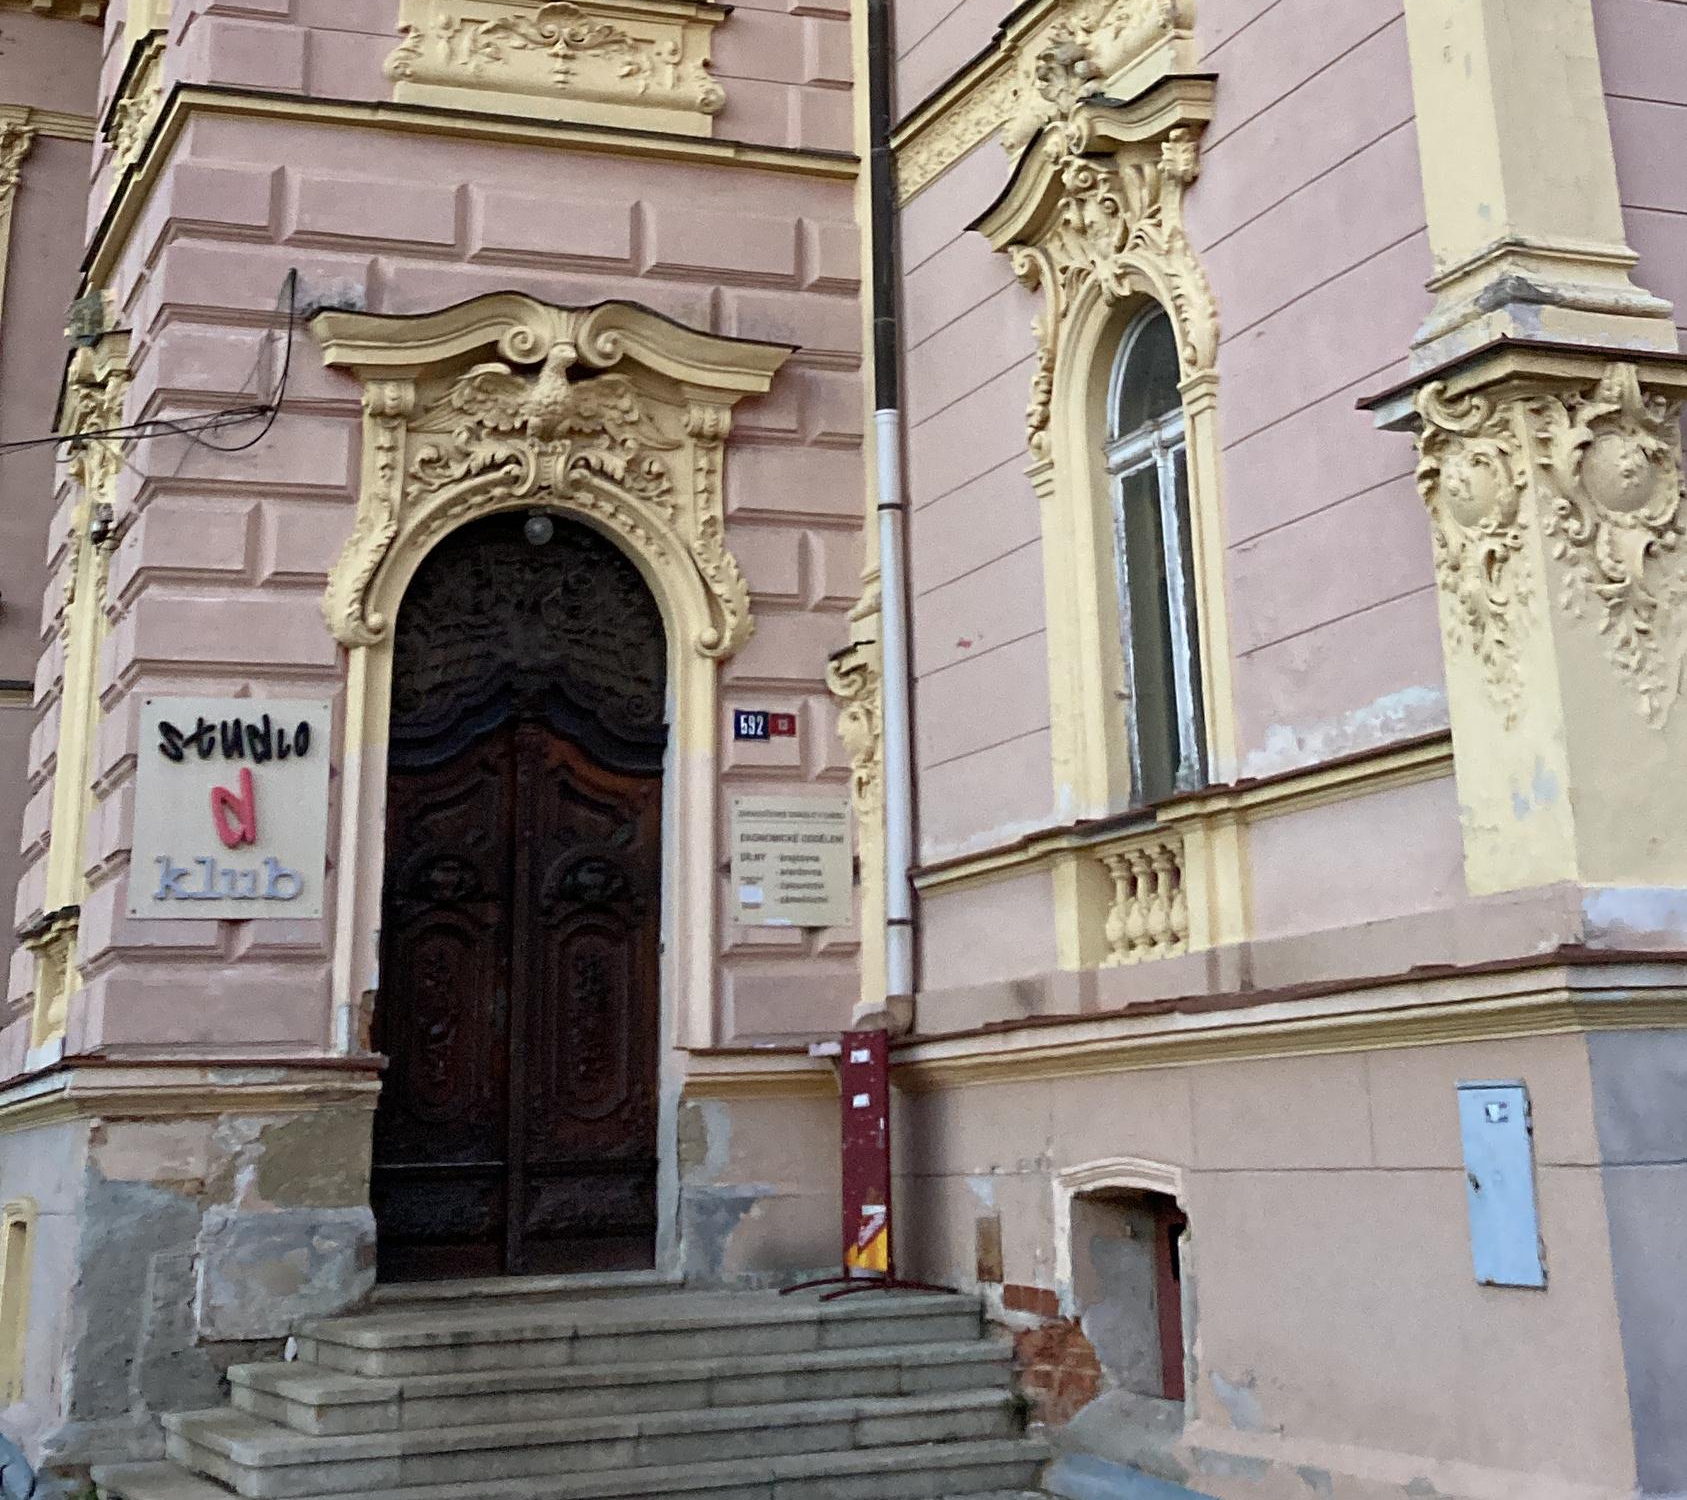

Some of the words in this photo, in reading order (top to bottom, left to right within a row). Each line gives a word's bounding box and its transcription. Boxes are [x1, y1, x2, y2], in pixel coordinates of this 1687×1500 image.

[158, 714, 311, 764] studio
[740, 715, 764, 735] 592
[211, 767, 256, 848] d
[153, 855, 304, 900] klub
